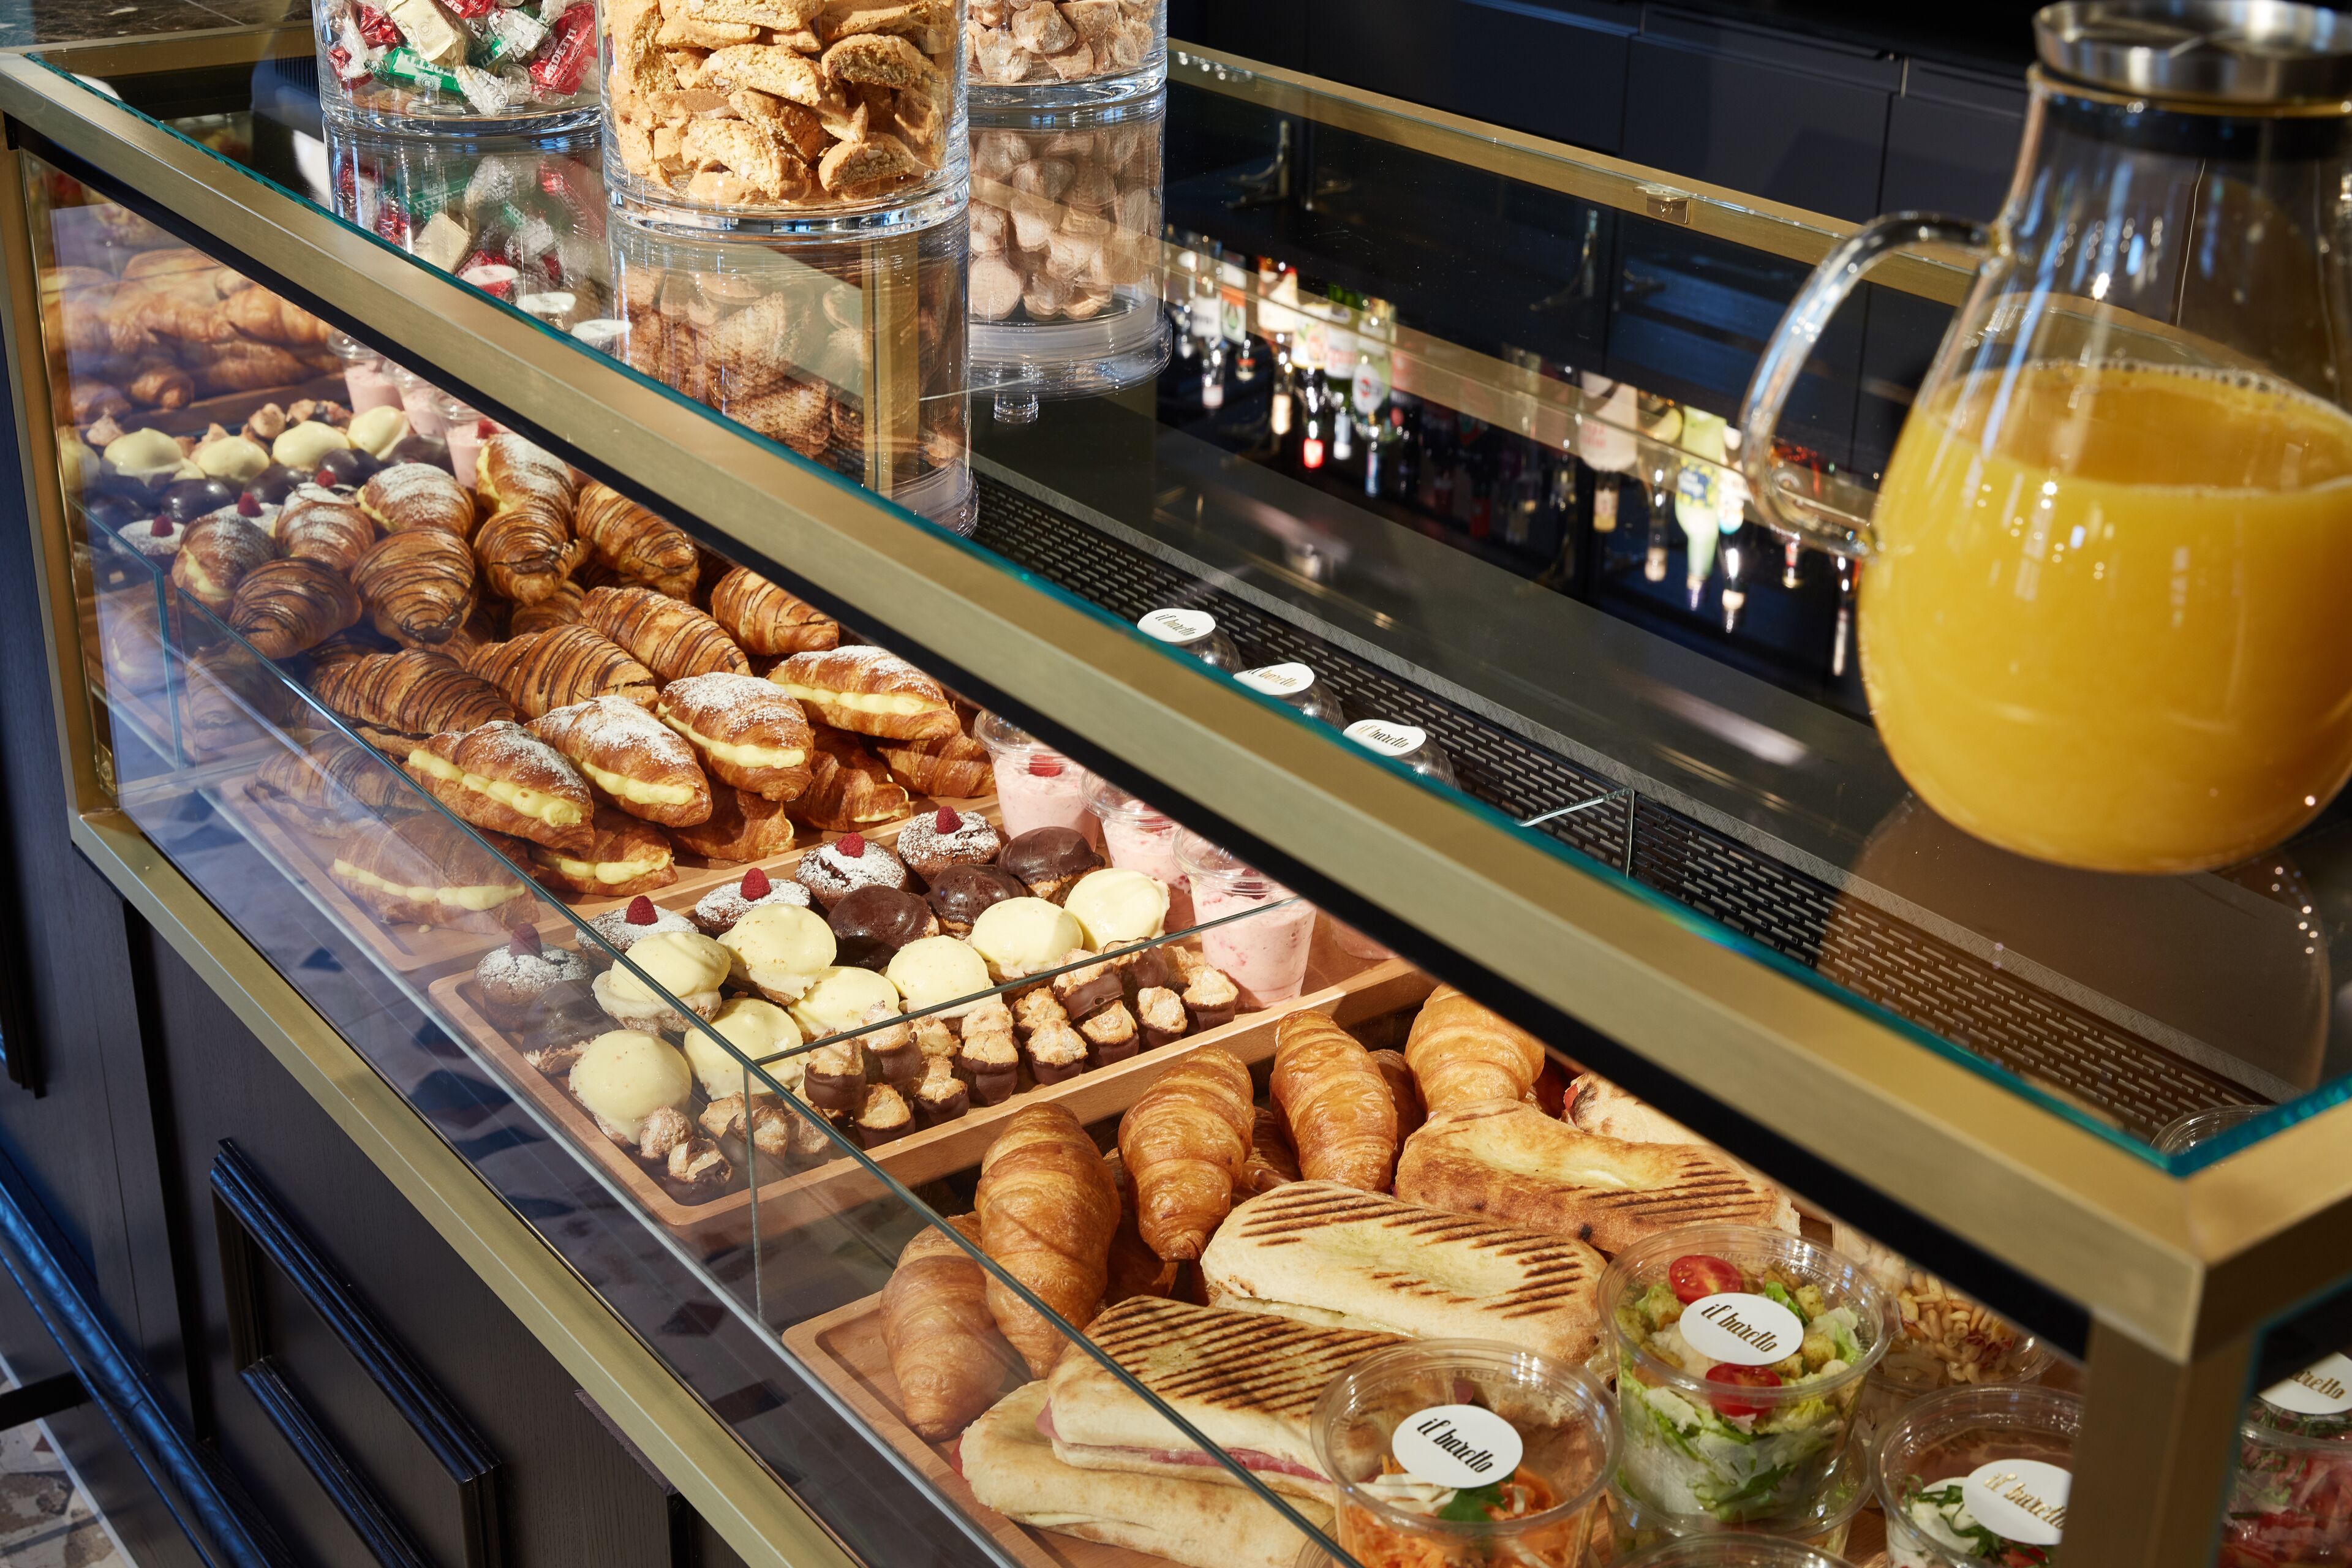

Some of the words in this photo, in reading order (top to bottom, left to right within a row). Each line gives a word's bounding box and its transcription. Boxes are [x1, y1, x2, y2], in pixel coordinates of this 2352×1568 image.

[1368, 728, 1409, 748] baretto
[1717, 1312, 1777, 1352] baretto
[1433, 1428, 1493, 1472] baretto
